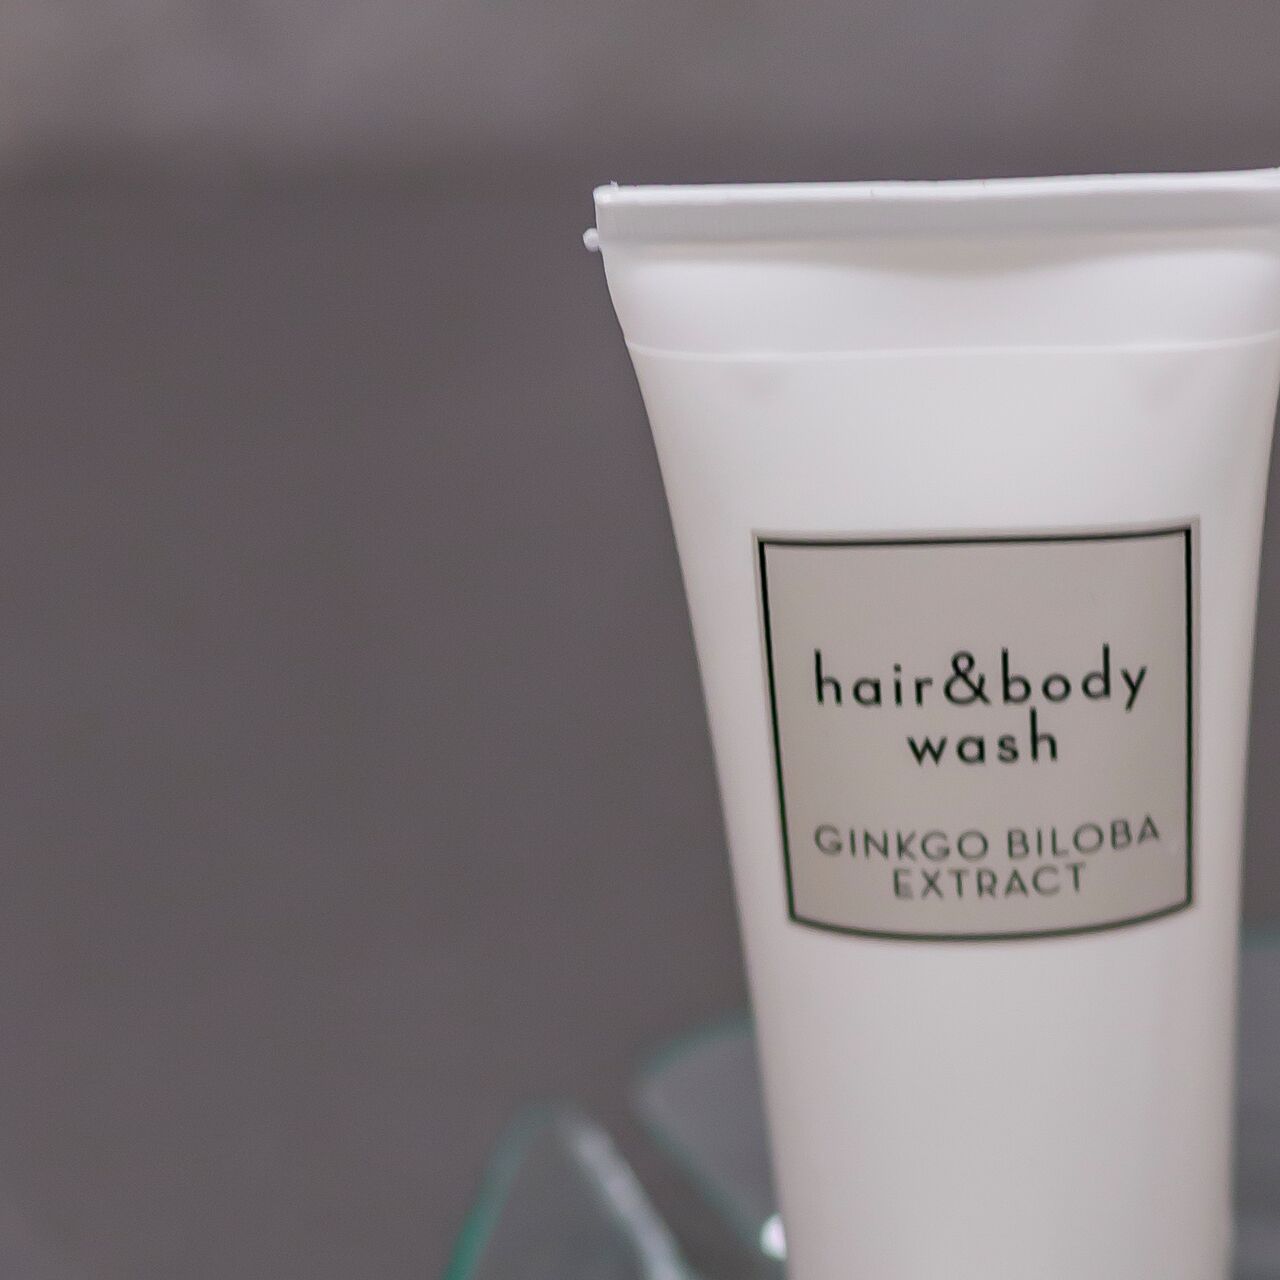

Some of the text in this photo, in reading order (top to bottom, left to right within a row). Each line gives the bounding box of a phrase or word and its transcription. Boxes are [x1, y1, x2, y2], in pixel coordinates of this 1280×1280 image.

[814, 643, 1147, 711] hair&body
[907, 707, 1057, 765] wash
[814, 815, 1160, 861] GINKGO BILOBA
[893, 862, 1086, 899] EXTRACT
